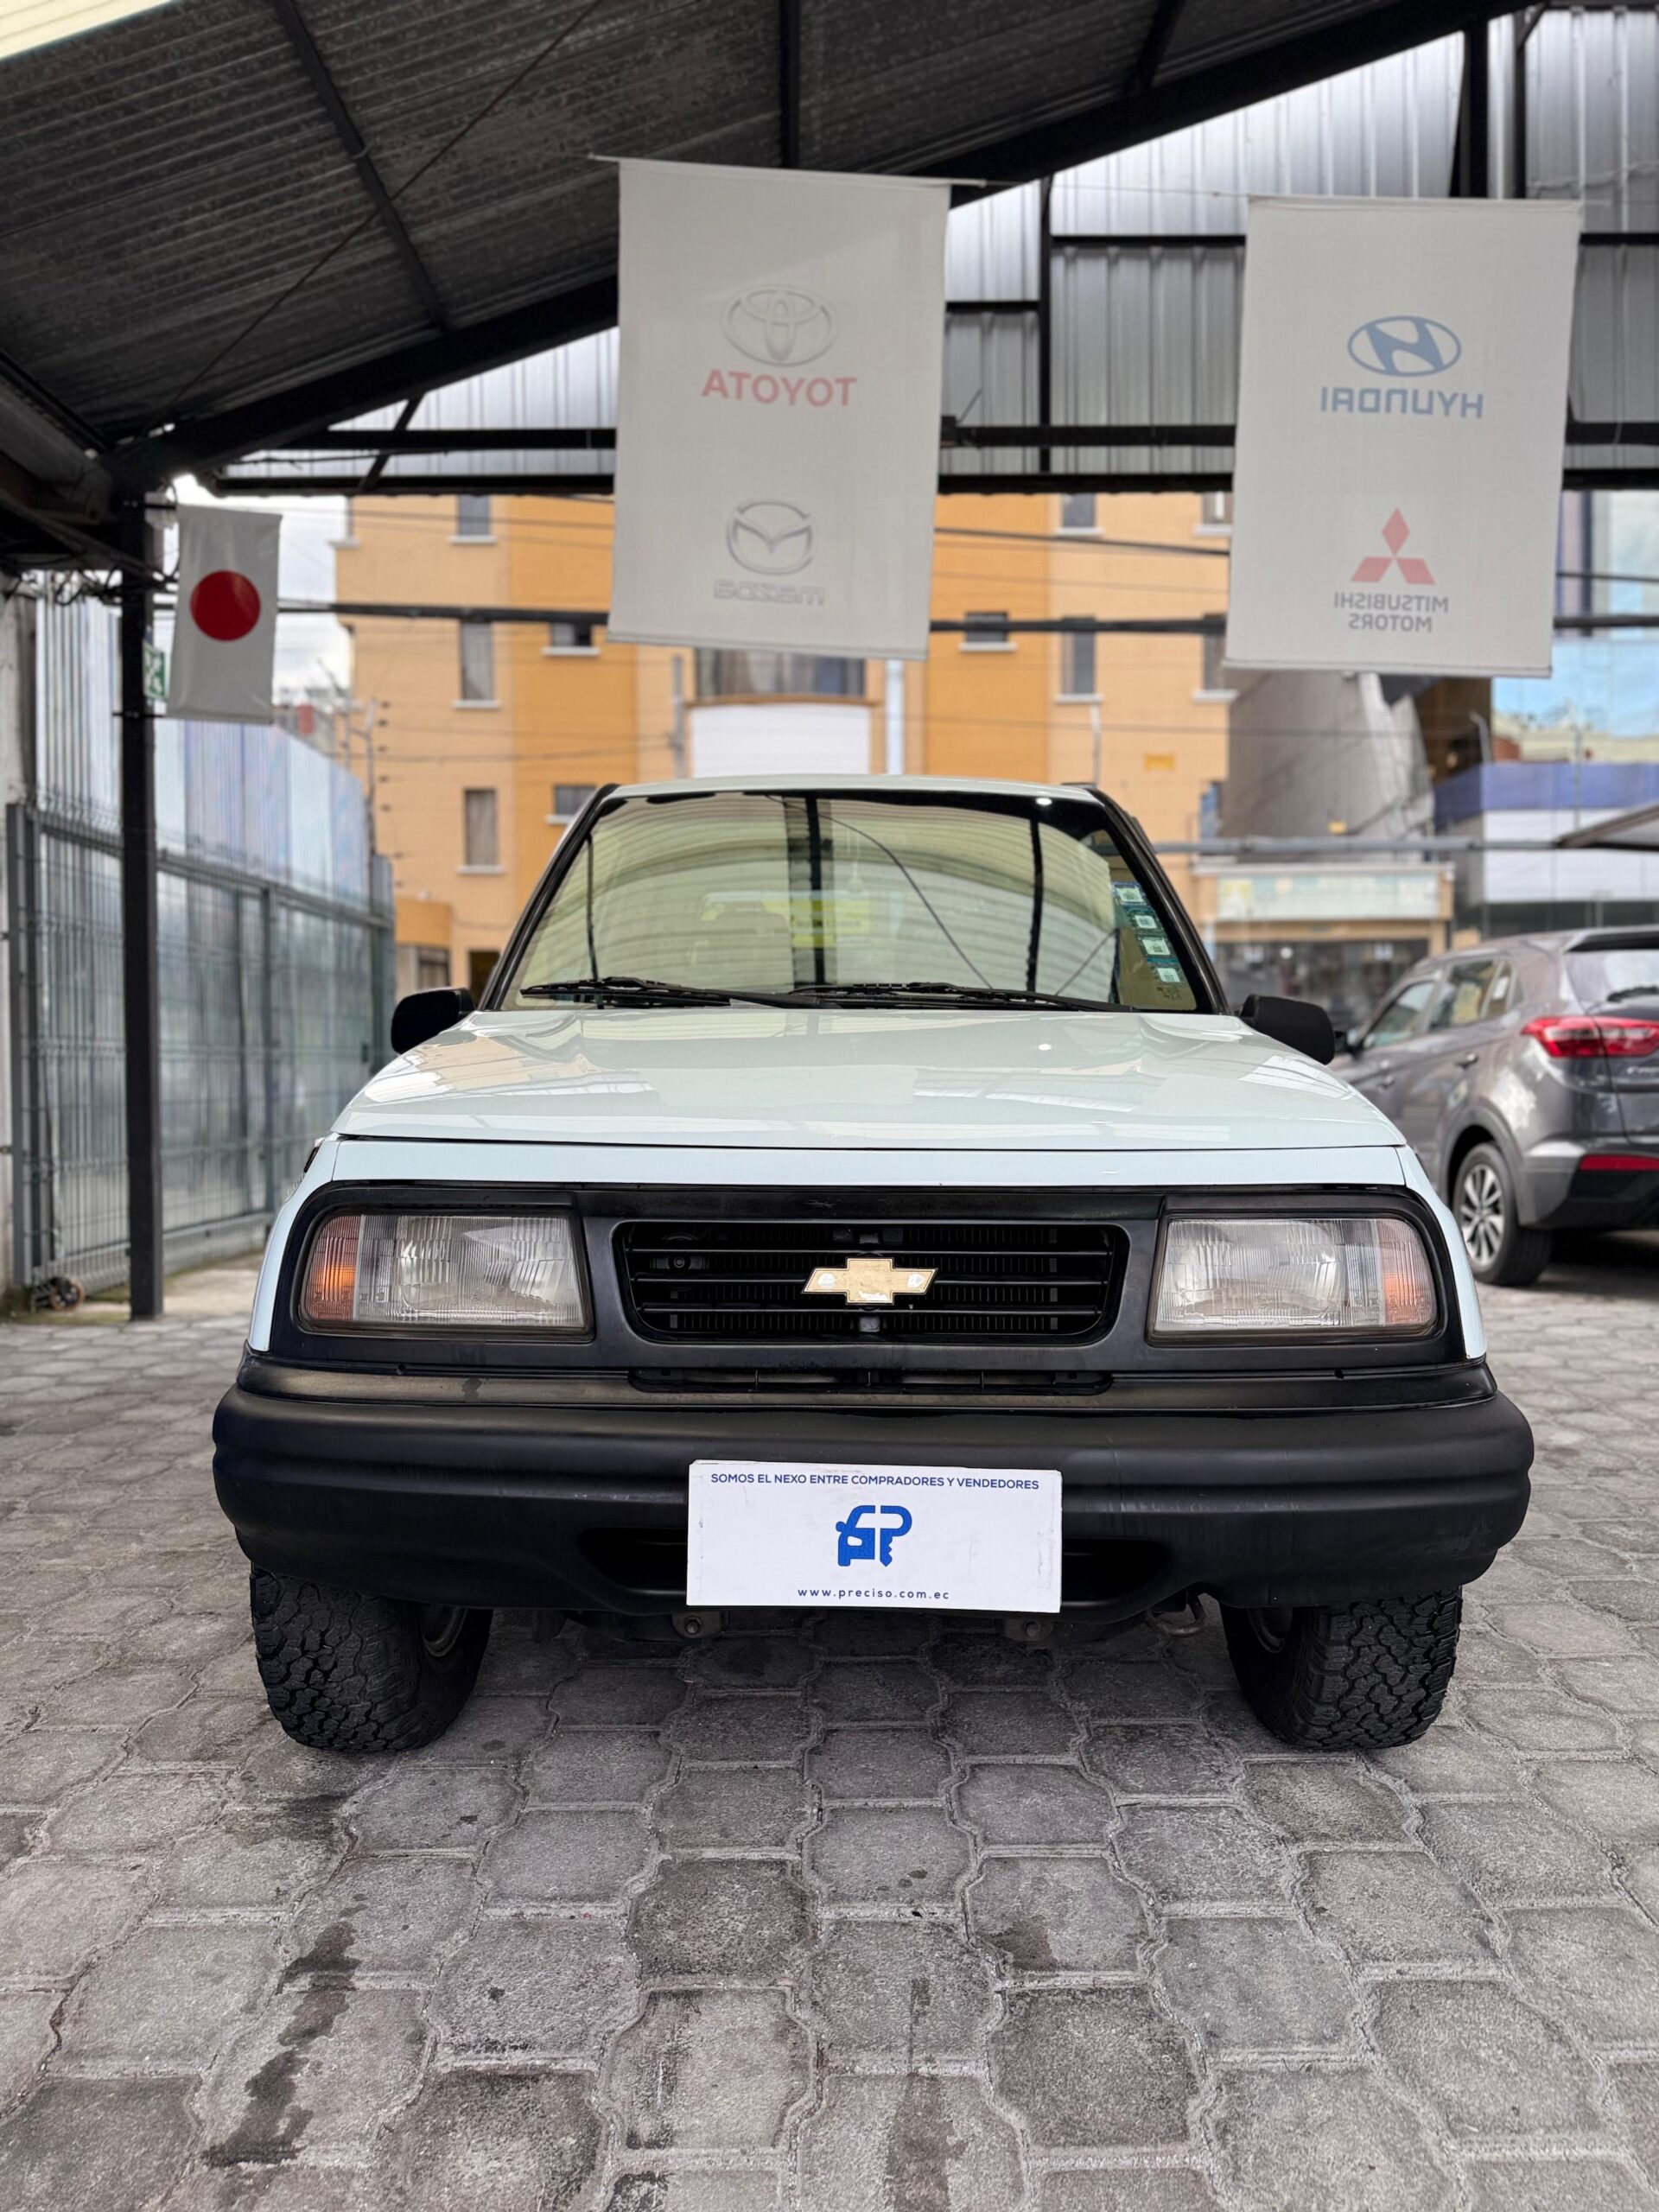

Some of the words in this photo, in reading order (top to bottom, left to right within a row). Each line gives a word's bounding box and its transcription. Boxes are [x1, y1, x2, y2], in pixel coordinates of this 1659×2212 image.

[710, 1473, 755, 1484] SOMOS
[757, 1474, 772, 1484] EL
[774, 1474, 807, 1484] NEXO
[810, 1475, 849, 1484] ENTRE
[851, 1476, 944, 1487] COMPRADORES
[947, 1478, 955, 1487] Y
[957, 1478, 1039, 1490] VENDEDORES
[797, 1588, 950, 1599] www.preciso.com.ec
